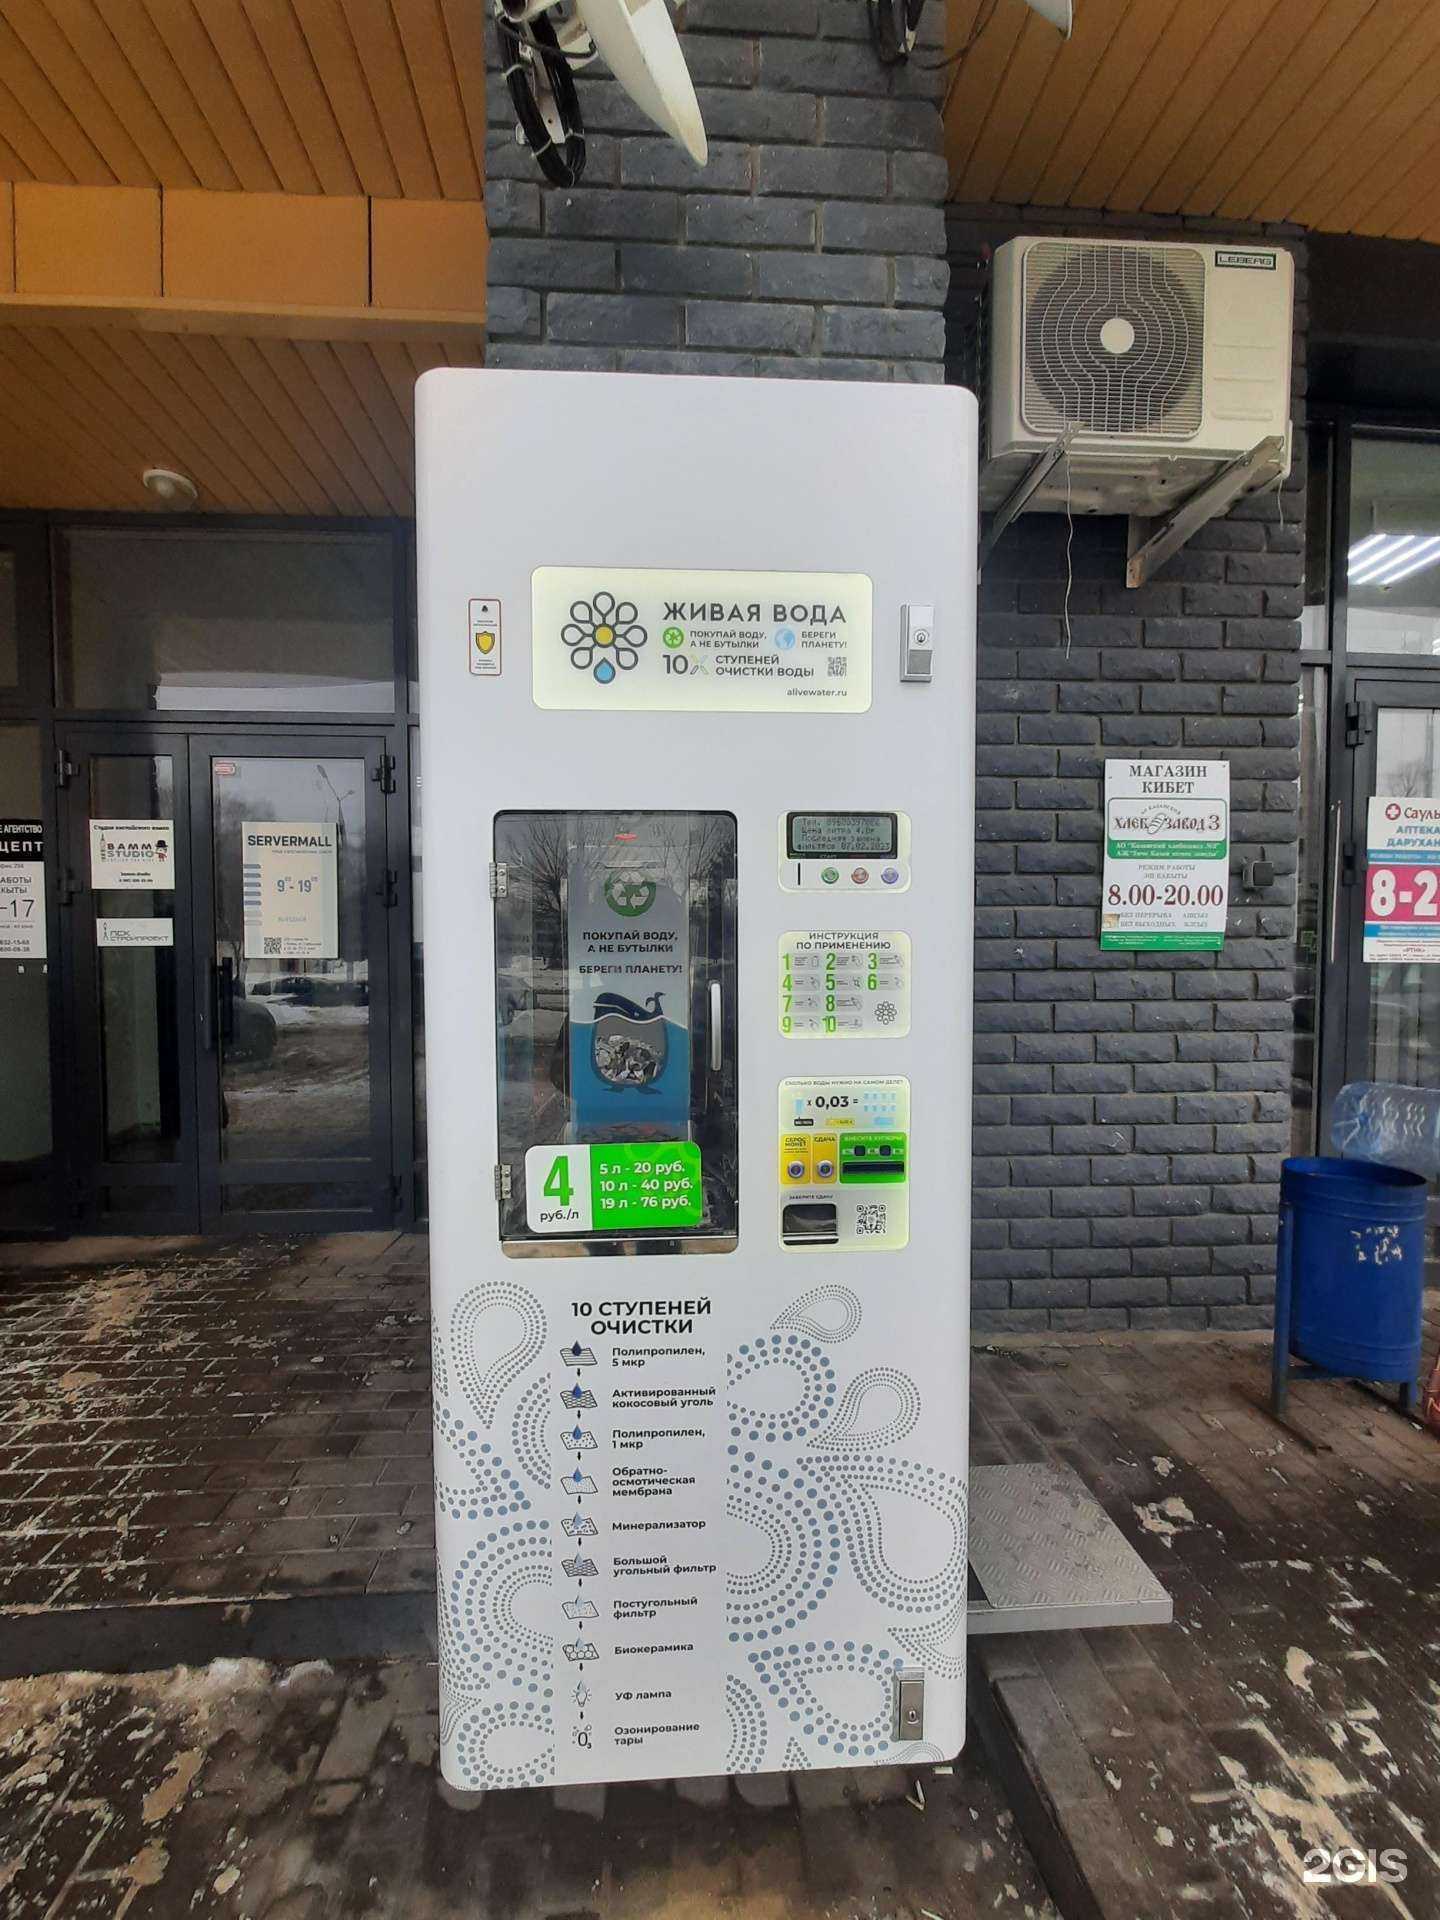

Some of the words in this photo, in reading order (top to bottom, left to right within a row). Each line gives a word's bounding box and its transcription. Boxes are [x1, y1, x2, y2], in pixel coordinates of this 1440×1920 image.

[662, 602, 761, 622] ЖИВАЯ
[773, 604, 847, 626] ВОДА
[690, 630, 736, 639] ПОКУПАЙ
[739, 631, 767, 640] ВОДУ,
[801, 631, 836, 639] БЕРЕГИ
[713, 641, 759, 649] БУТЫЛКИ
[801, 641, 847, 649] ПЛАНЕТУ!
[715, 654, 780, 665] СТУПЕНЕЙ
[715, 667, 773, 676] ОЧИСТКИ
[777, 667, 814, 678] ВОДЫ
[787, 687, 847, 697] alivewater.ru
[1129, 765, 1208, 778] МАГАЗИН
[1142, 781, 1195, 793] КИБЕТ
[4, 824, 43, 834] АГЕНТСТВО
[1208, 814, 1220, 831] 3
[247, 834, 332, 847] SERVERMALL
[107, 850, 154, 858] STUDIO
[1108, 884, 1224, 906] 8.00-20.00
[583, 929, 641, 941] ПОКУПАЙ
[643, 931, 678, 942] ВОДУ,
[809, 932, 879, 941] ИНСТРУКЦИЯ
[587, 944, 596, 953] А
[599, 944, 614, 953] НЕ
[617, 944, 673, 953] БУТЫЛКИ
[796, 941, 812, 950] ПО
[814, 941, 891, 950] ПРИМЕНЕНИЮ
[782, 953, 790, 970] 1
[826, 953, 836, 970] 2
[868, 953, 877, 970] 3
[579, 965, 622, 974] БЕРЕГИ
[625, 965, 683, 974] ПЛАНЕТУ!
[782, 974, 793, 991] 4
[826, 974, 835, 991] 5
[867, 974, 877, 991] 6
[782, 995, 792, 1012] 7
[826, 994, 835, 1012] 8
[782, 1016, 791, 1033] 9
[822, 1015, 836, 1033] 10
[815, 1096, 849, 1110] 0,03
[600, 1163, 609, 1175] 5
[611, 1165, 621, 1174] л
[634, 1162, 651, 1174] 20
[655, 1160, 685, 1175] руб.
[543, 1155, 574, 1207] 4
[600, 1180, 614, 1192] 10
[618, 1182, 628, 1191] л
[641, 1179, 660, 1190] 40
[664, 1178, 693, 1192] руб.
[601, 1198, 614, 1209] 19
[618, 1199, 628, 1209] л
[641, 1196, 658, 1208] 76
[662, 1195, 691, 1209] руб.
[540, 1208, 579, 1223] руб./л
[571, 1302, 592, 1317] 10
[599, 1296, 711, 1316] СТУПЕНЕЙ
[591, 1319, 693, 1335] ОЧИСТКИ
[612, 1347, 705, 1357] Полипропилен,
[612, 1358, 619, 1366] 5
[621, 1359, 645, 1368] мкр
[612, 1386, 716, 1399] Активированный
[612, 1398, 677, 1408] кокосовый
[680, 1399, 714, 1408] уголь
[612, 1429, 705, 1440] Полипропилен,
[612, 1440, 617, 1448] 1
[619, 1441, 643, 1449] мкр
[612, 1467, 668, 1478] Обратно-
[612, 1476, 696, 1486] осмотическая
[612, 1487, 673, 1497] мембрана
[612, 1519, 706, 1532] Минерализатор
[613, 1554, 667, 1566] Большой
[613, 1565, 671, 1577] угольный
[673, 1563, 717, 1576] фильтр
[613, 1596, 698, 1610] Постугольный
[613, 1608, 657, 1620] фильтр
[614, 1642, 694, 1655] Биокерамика
[615, 1690, 634, 1701] УФ
[635, 1690, 672, 1701] лампа
[614, 1723, 700, 1736] Озонирование
[614, 1735, 644, 1746] тары
